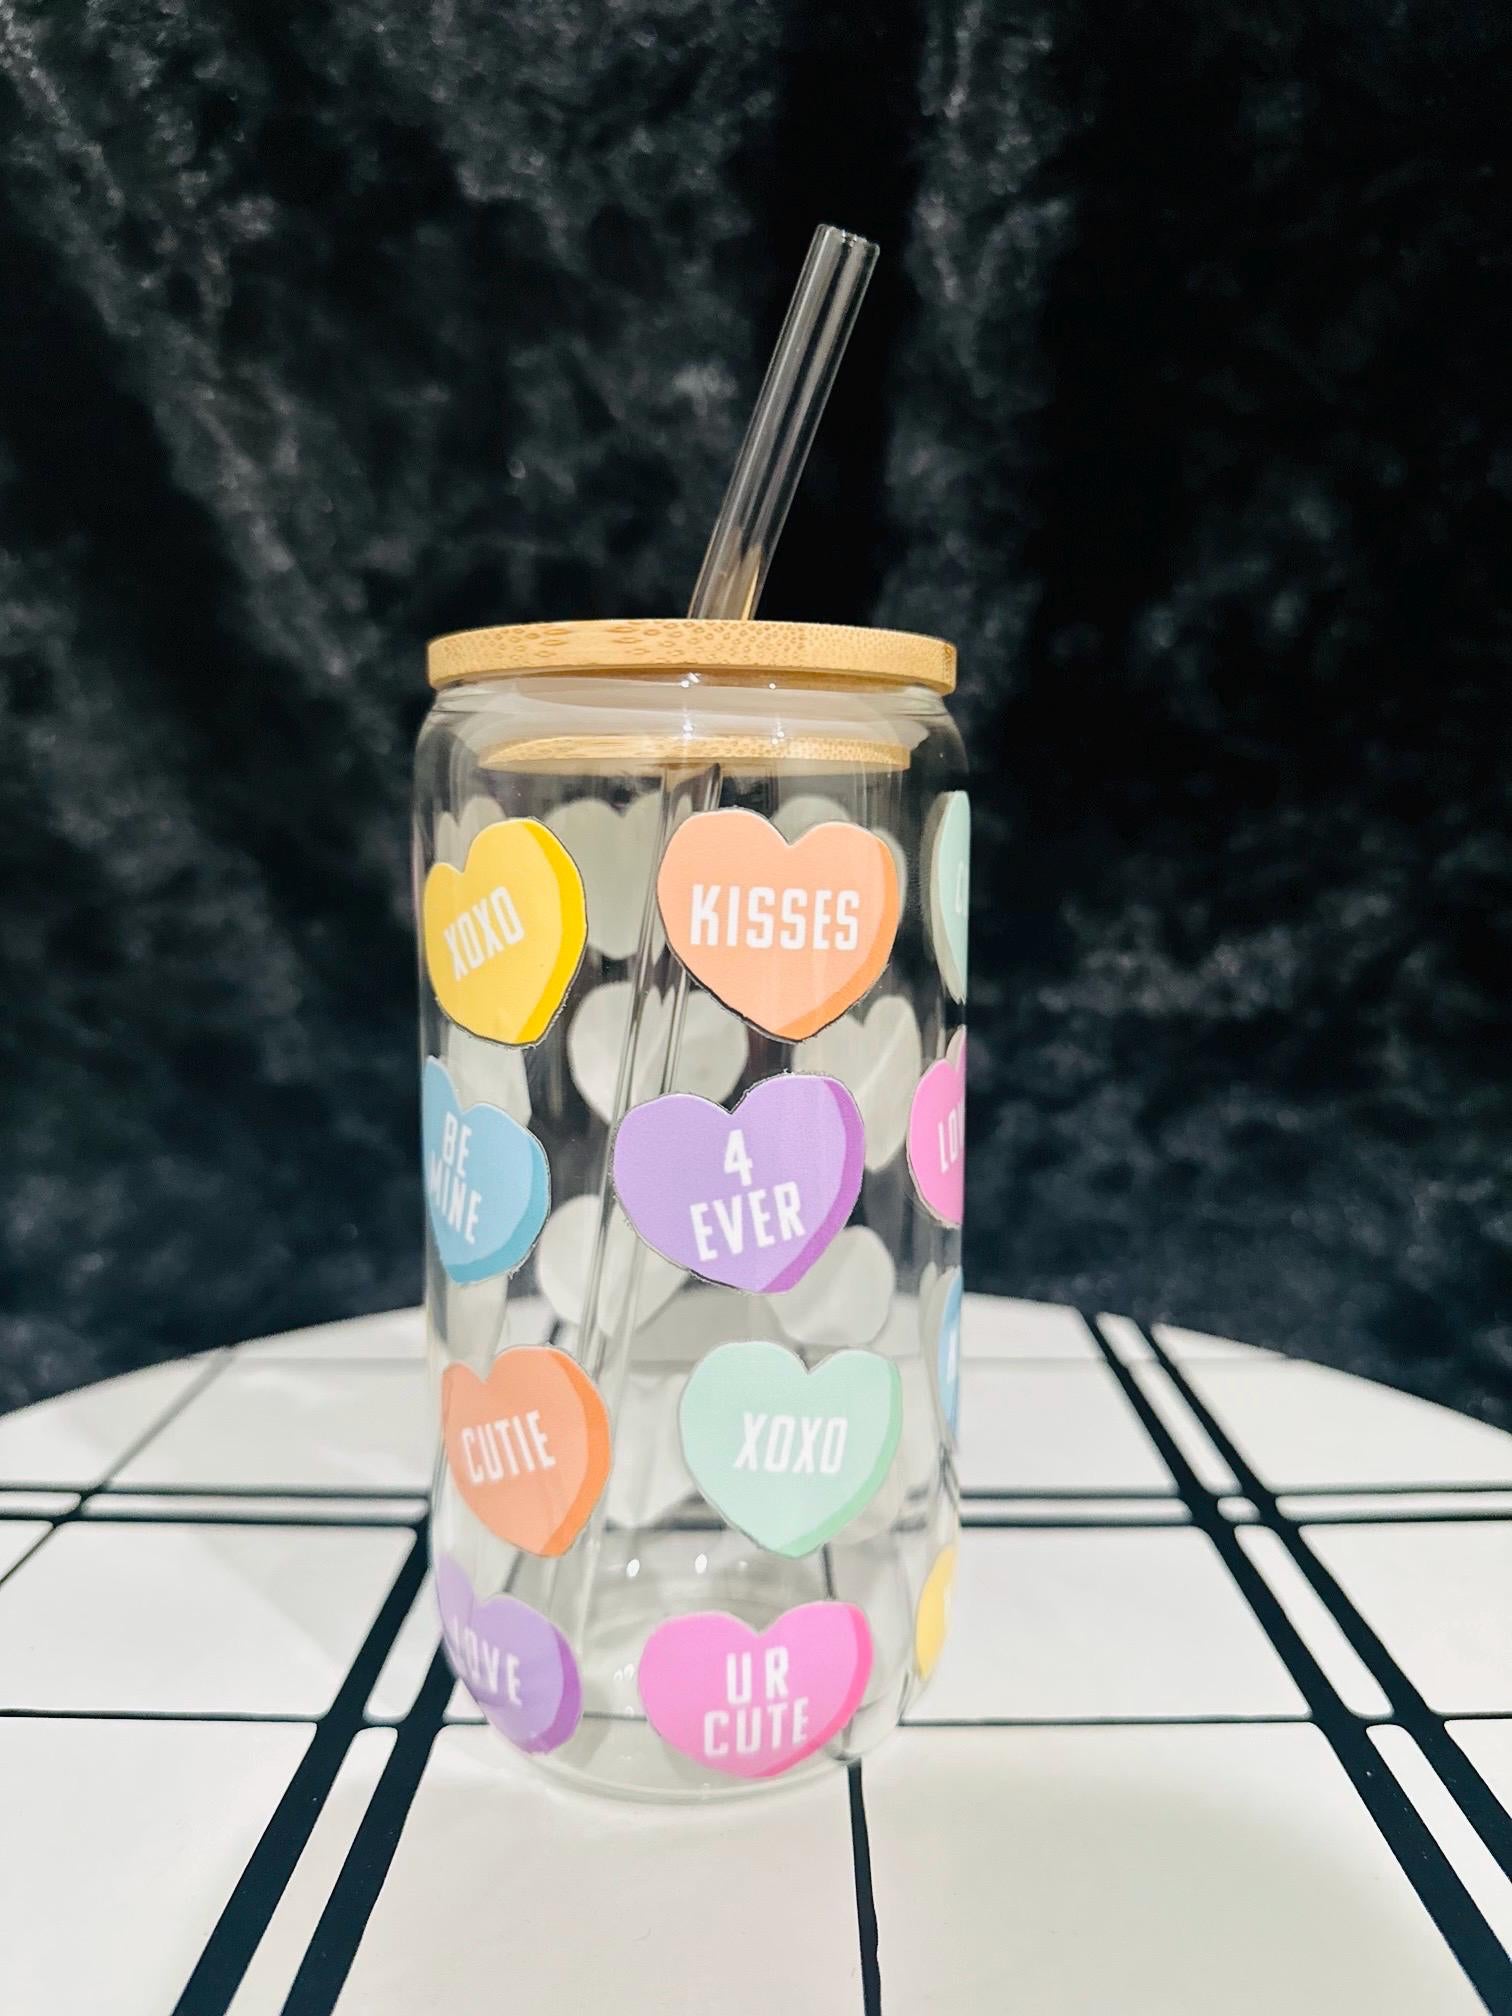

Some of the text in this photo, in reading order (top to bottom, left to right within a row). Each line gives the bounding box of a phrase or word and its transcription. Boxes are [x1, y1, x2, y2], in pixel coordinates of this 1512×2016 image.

[444, 886, 525, 982] XOXO
[690, 884, 860, 950] KISSES
[442, 1111, 472, 1177] BE
[724, 1129, 753, 1187] 4
[690, 1181, 806, 1262] EVER
[461, 1409, 556, 1484] CUTIE
[733, 1412, 848, 1474] XOXO
[726, 1646, 789, 1705] U R
[703, 1697, 808, 1758] CUTE
